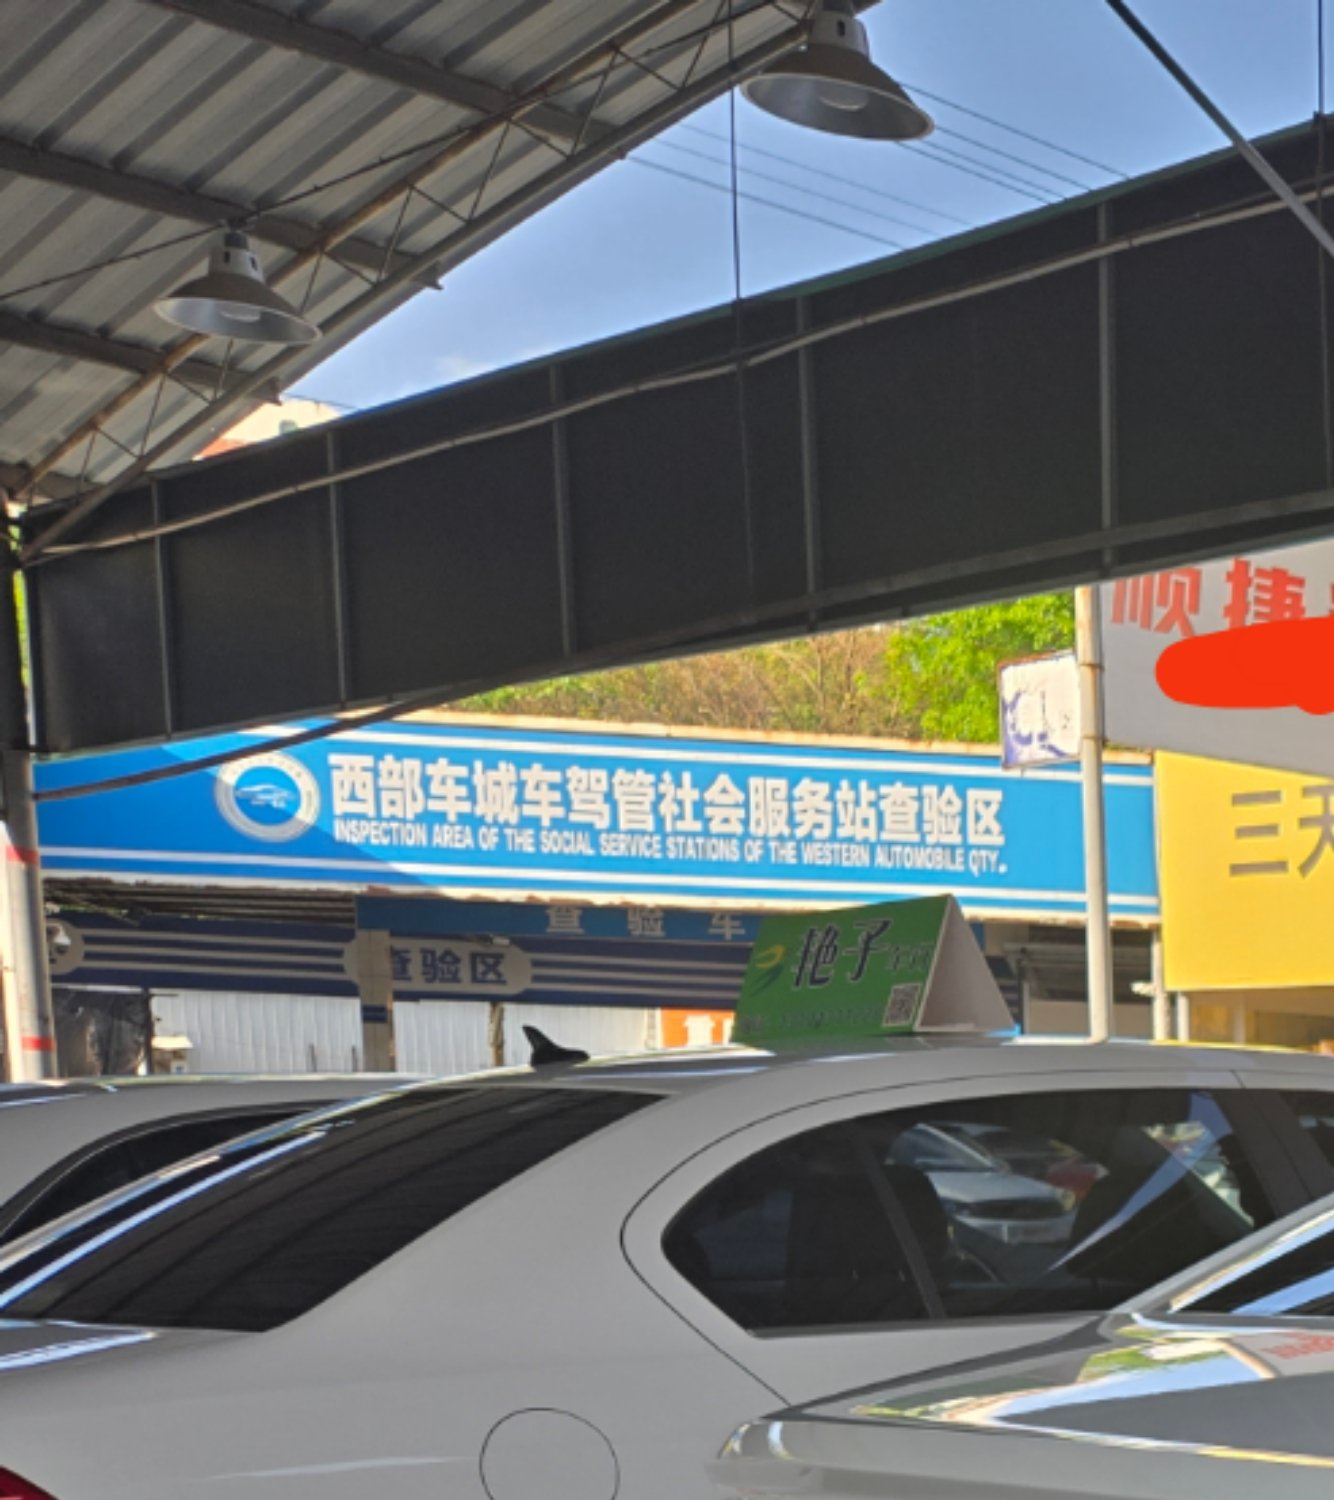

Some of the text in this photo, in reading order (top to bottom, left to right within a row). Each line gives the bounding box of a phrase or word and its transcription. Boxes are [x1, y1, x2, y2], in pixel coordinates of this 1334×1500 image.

[328, 752, 1004, 847] 西部车城车驾管社会服务站查验区
[334, 819, 428, 847] INSPECTION
[431, 824, 474, 849] AREA
[478, 827, 500, 850] OF
[503, 828, 536, 852] THE
[540, 831, 595, 856] SOCIAL
[600, 834, 662, 858] SERVICE
[665, 835, 740, 862] STATIONS
[744, 839, 764, 862] OF
[768, 840, 798, 864] THE
[801, 842, 870, 867] WESTERN
[873, 844, 965, 871] AUTOMOBILE
